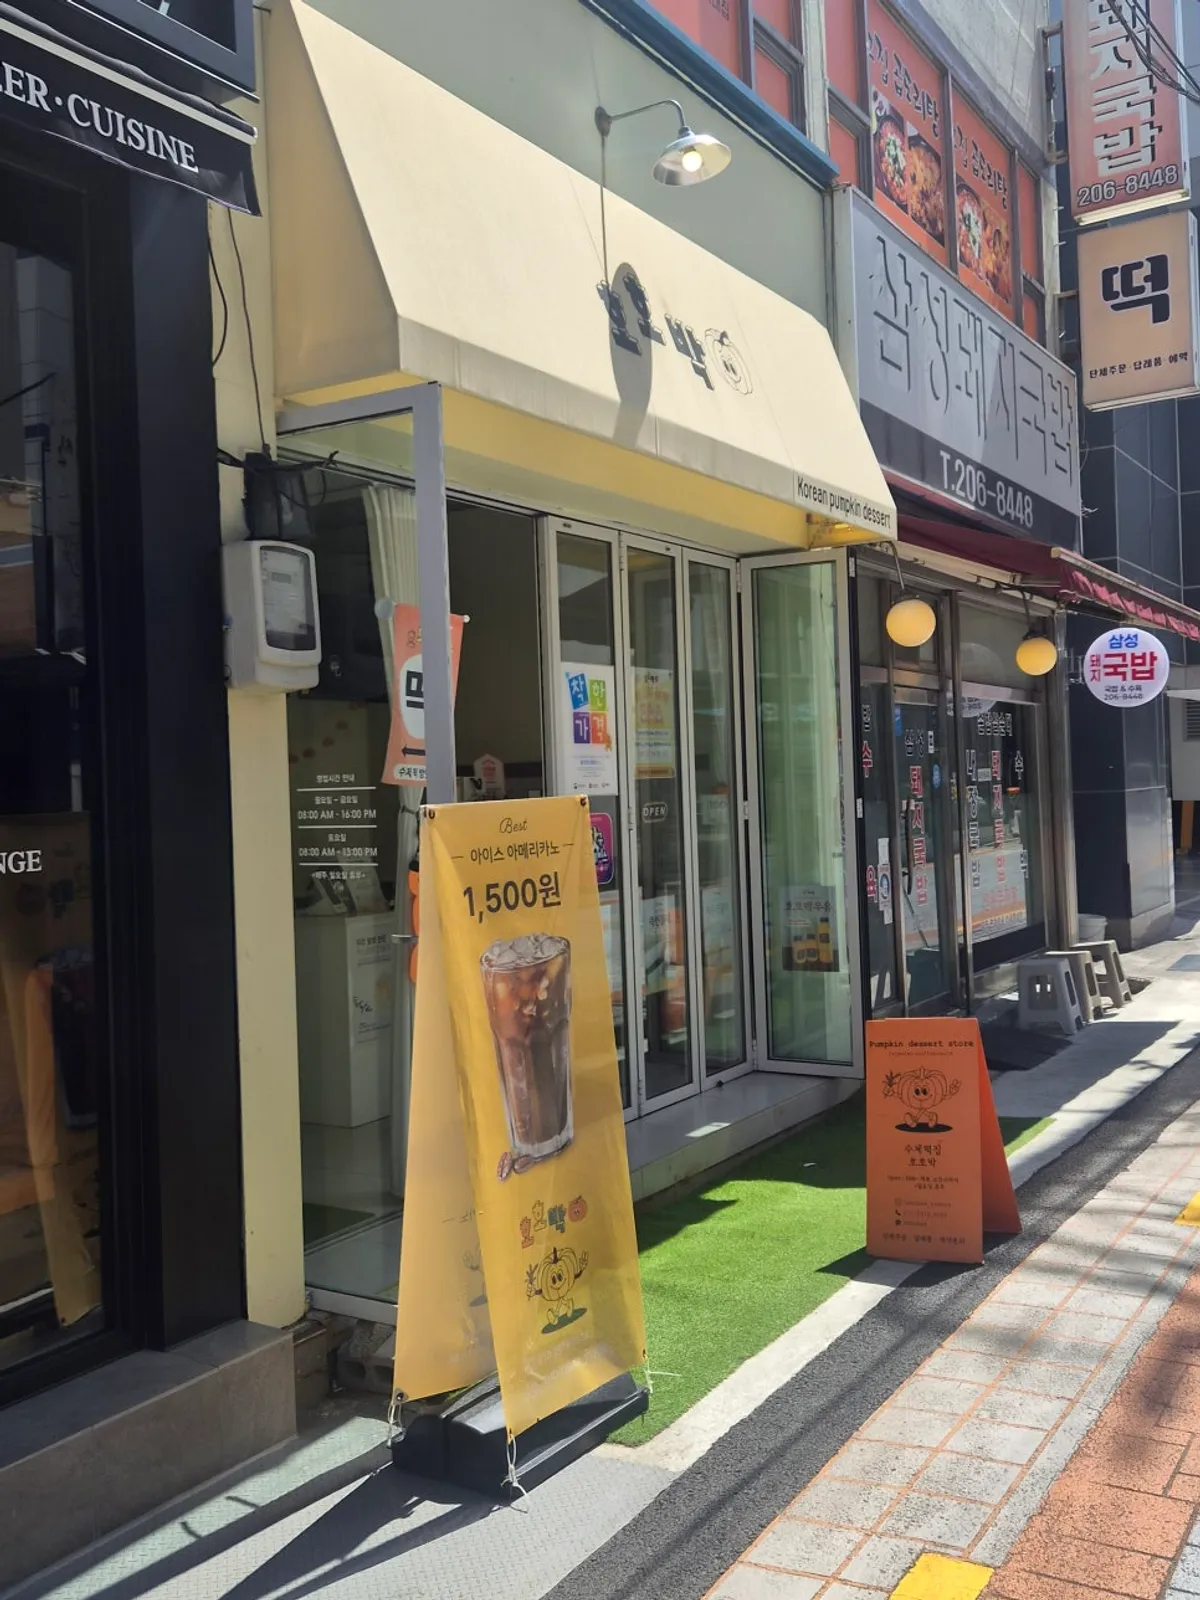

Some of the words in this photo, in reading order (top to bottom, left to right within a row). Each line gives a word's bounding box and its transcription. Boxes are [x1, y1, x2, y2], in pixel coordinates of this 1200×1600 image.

[1078, 165, 1179, 207] 206-8448
[1101, 253, 1170, 324] 떡
[1089, 364, 1127, 379] 단체주문
[797, 475, 828, 506] Korean
[829, 491, 862, 517] pumpkin
[862, 502, 891, 529] dessert
[939, 450, 1034, 528] T.206-8448
[1108, 633, 1138, 649] 삼성
[1089, 654, 1101, 682] 돼지
[1103, 651, 1158, 682] 국밥
[320, 810, 334, 819] AM
[363, 809, 377, 818] PM
[643, 806, 667, 817] OPEN
[499, 817, 528, 834] Best
[909, 764, 929, 907] 돼지국밥
[321, 847, 335, 856] AM
[365, 847, 378, 856] PM
[470, 845, 505, 866] 아이스
[506, 840, 561, 862] 아메리카노
[463, 871, 562, 924] 1,500원
[869, 1040, 904, 1049] Pumpkin
[908, 1039, 944, 1048] dessert
[948, 1039, 974, 1048] store
